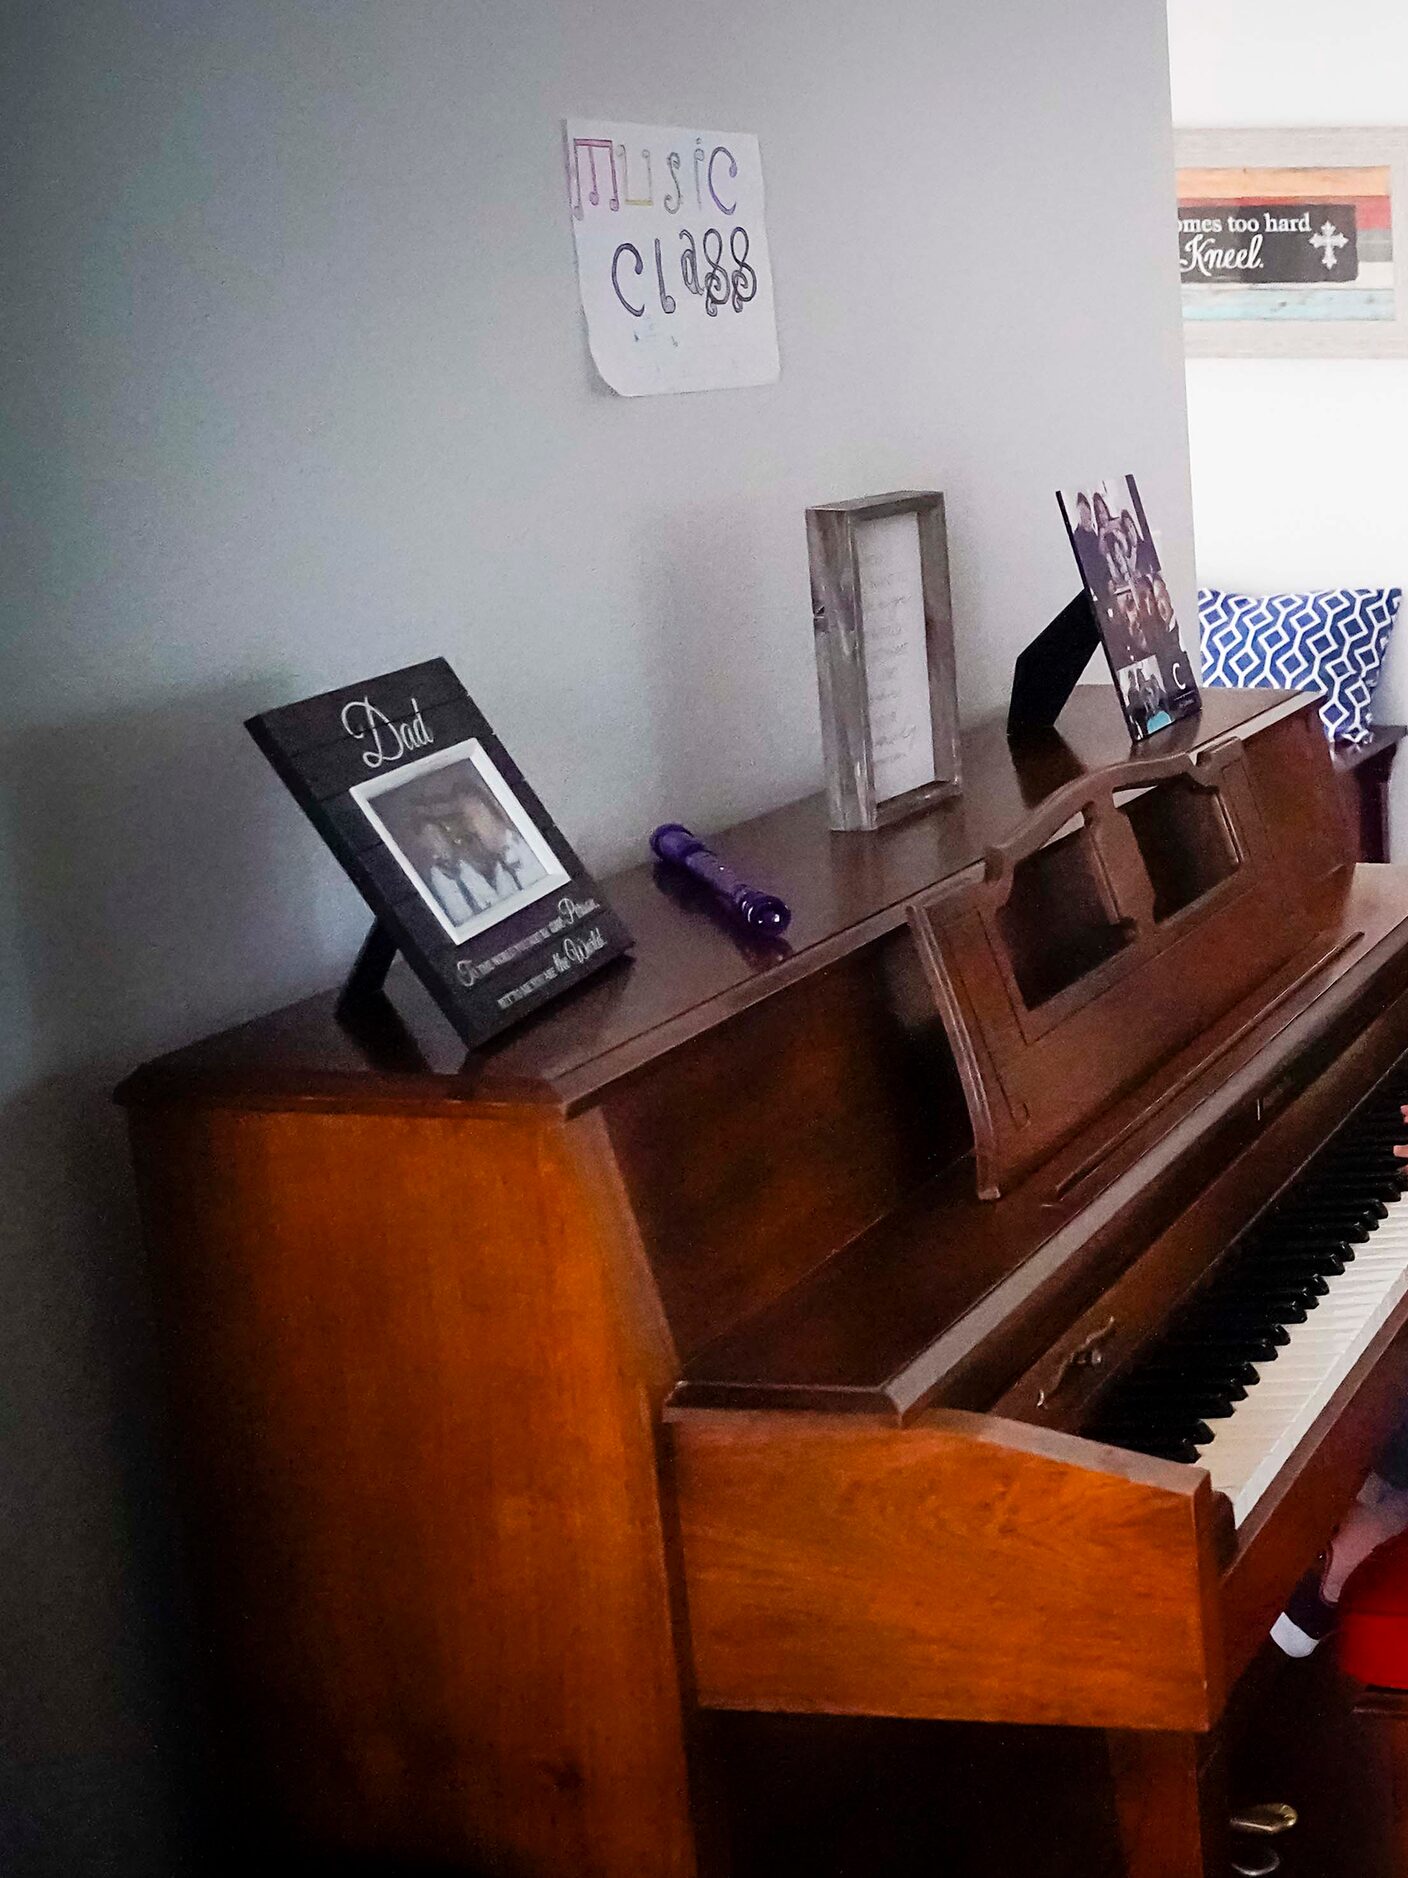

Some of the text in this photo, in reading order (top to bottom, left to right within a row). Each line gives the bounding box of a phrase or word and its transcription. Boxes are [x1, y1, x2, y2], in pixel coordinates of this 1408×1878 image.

[1227, 216, 1260, 232] too
[1263, 211, 1312, 232] hard
[1179, 233, 1264, 277] Kneel.
[1172, 662, 1186, 690] C
[341, 695, 434, 768] Dad
